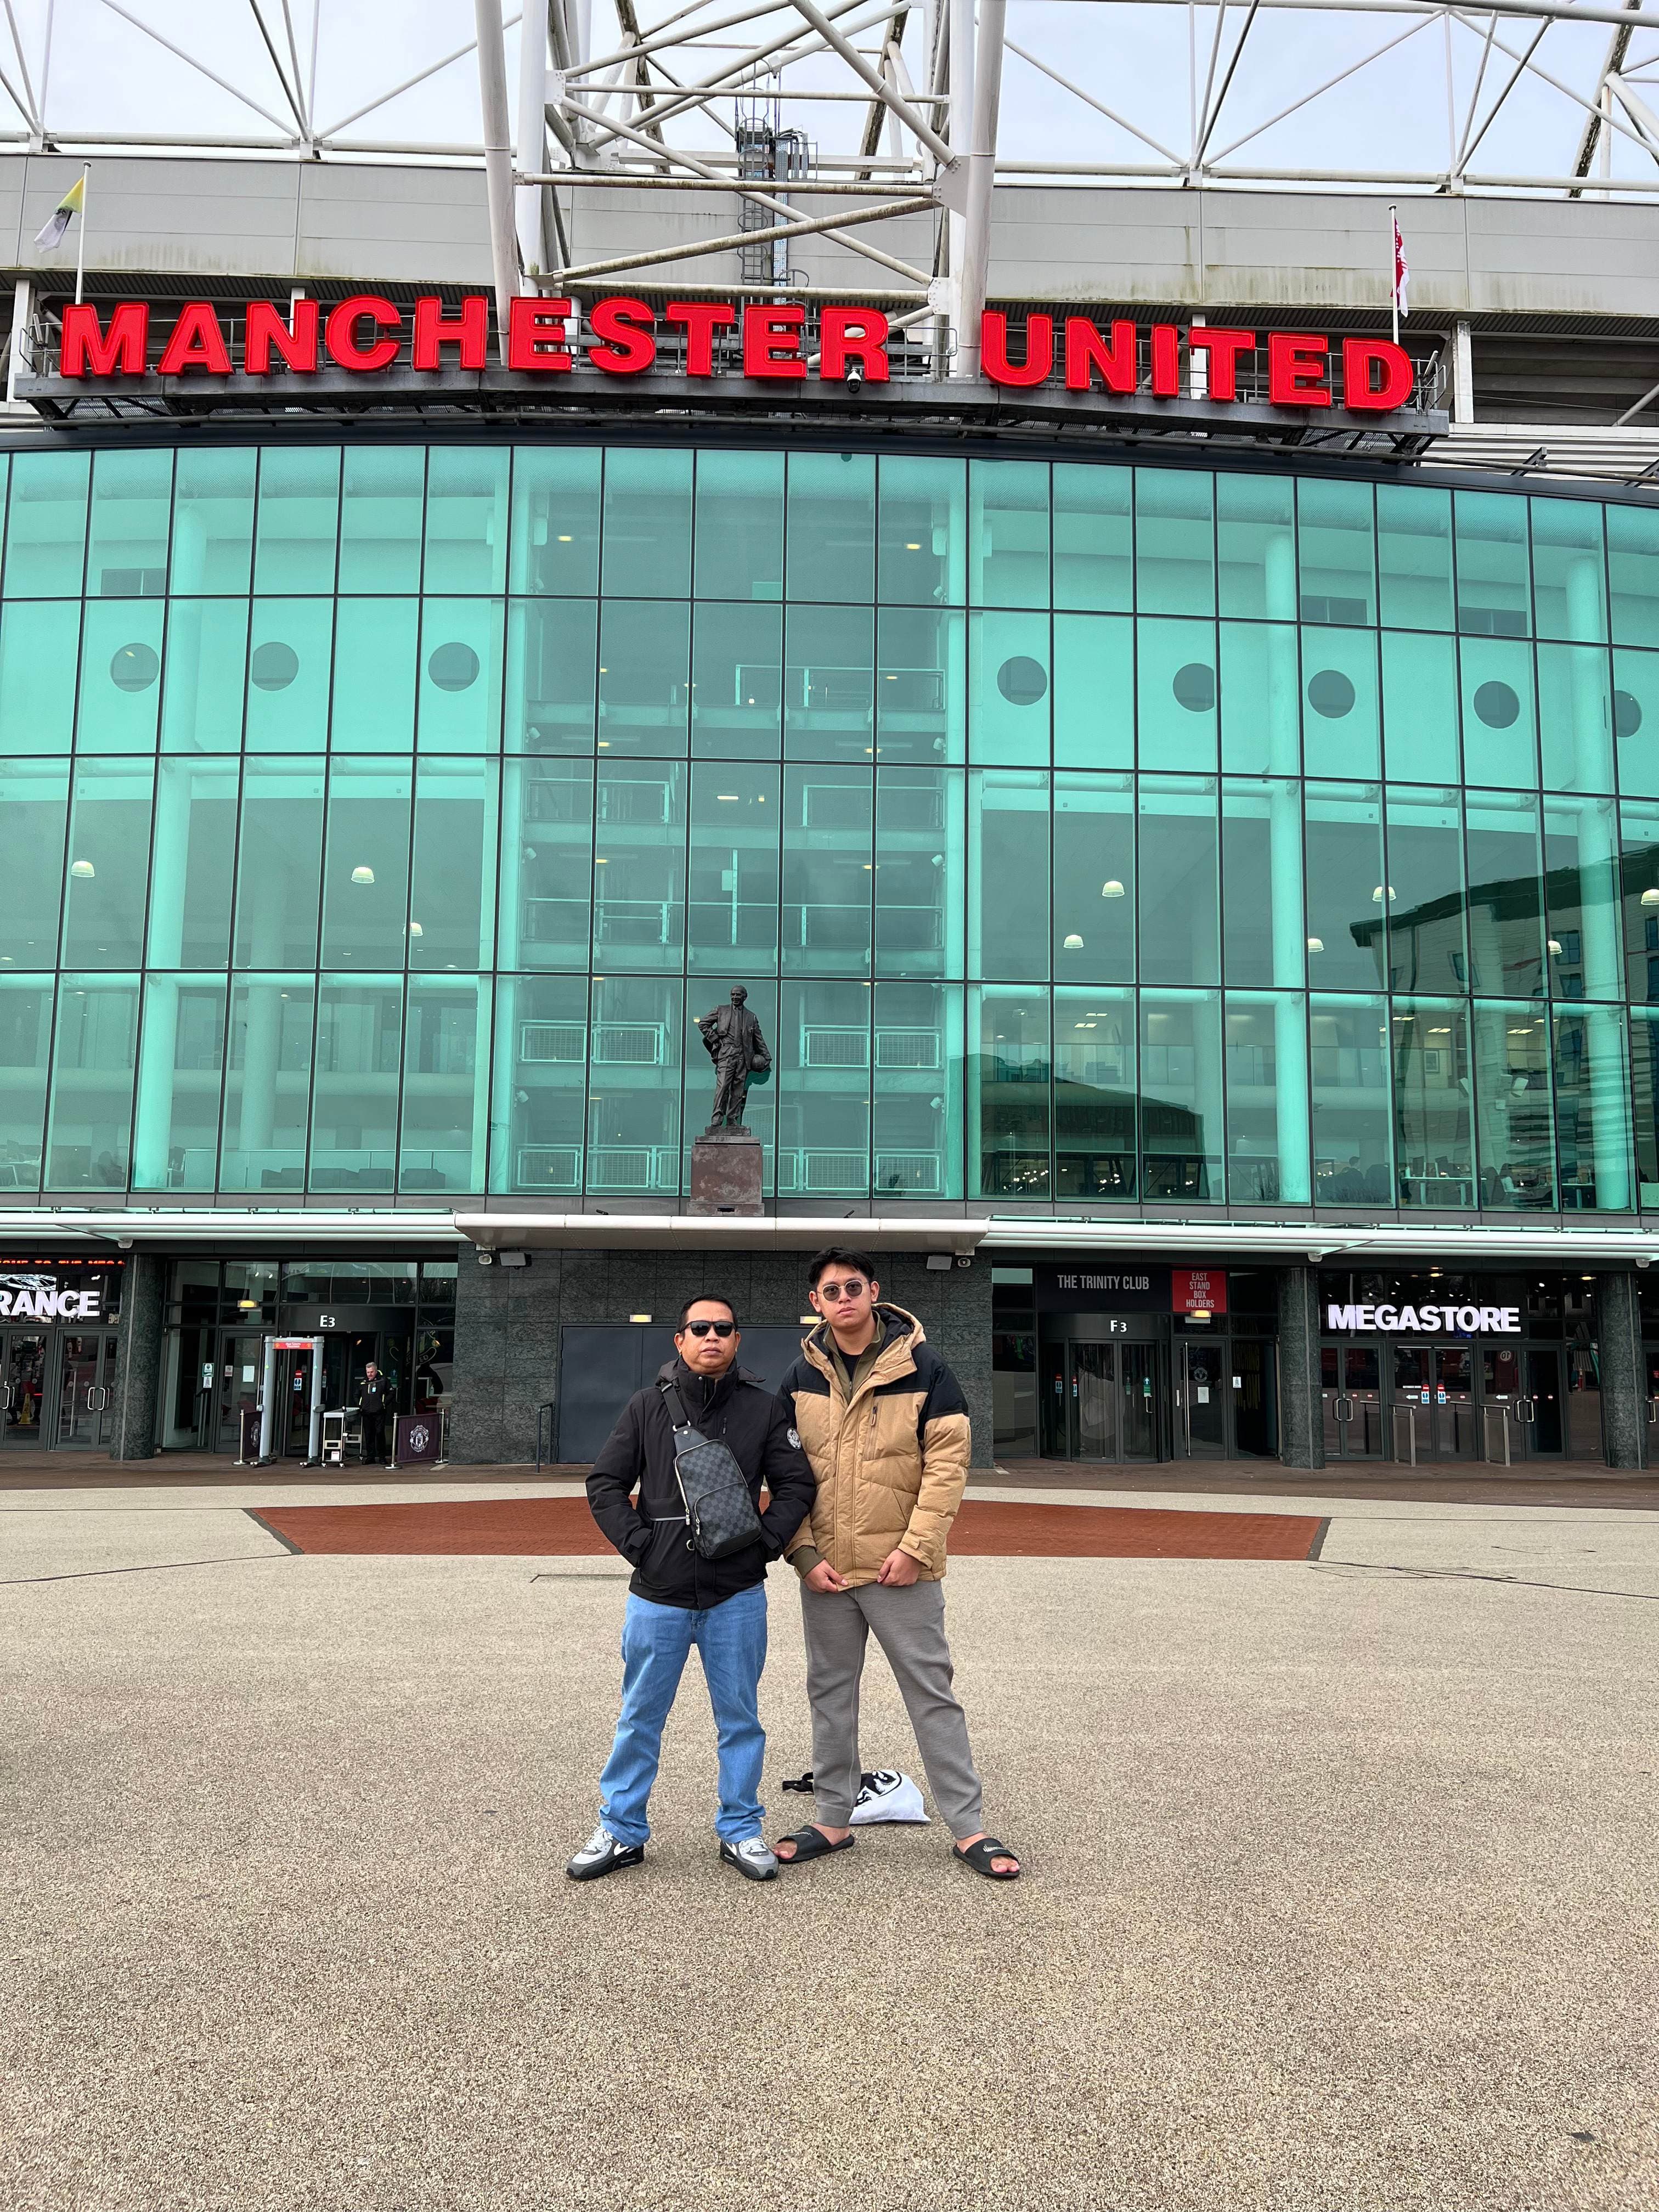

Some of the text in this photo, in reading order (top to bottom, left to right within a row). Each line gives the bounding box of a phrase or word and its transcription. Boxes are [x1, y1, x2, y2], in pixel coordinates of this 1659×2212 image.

[60, 294, 1414, 412] MANCHESTER UNITED
[1057, 1274, 1149, 1290] THE TRINITY CLUB
[1192, 1272, 1207, 1281] EAST
[1189, 1281, 1210, 1290] STAND
[1193, 1290, 1206, 1299] BOX
[1186, 1299, 1215, 1308] HOLDERS
[320, 1315, 335, 1328] E3
[1328, 1304, 1521, 1332] MEGASTORE
